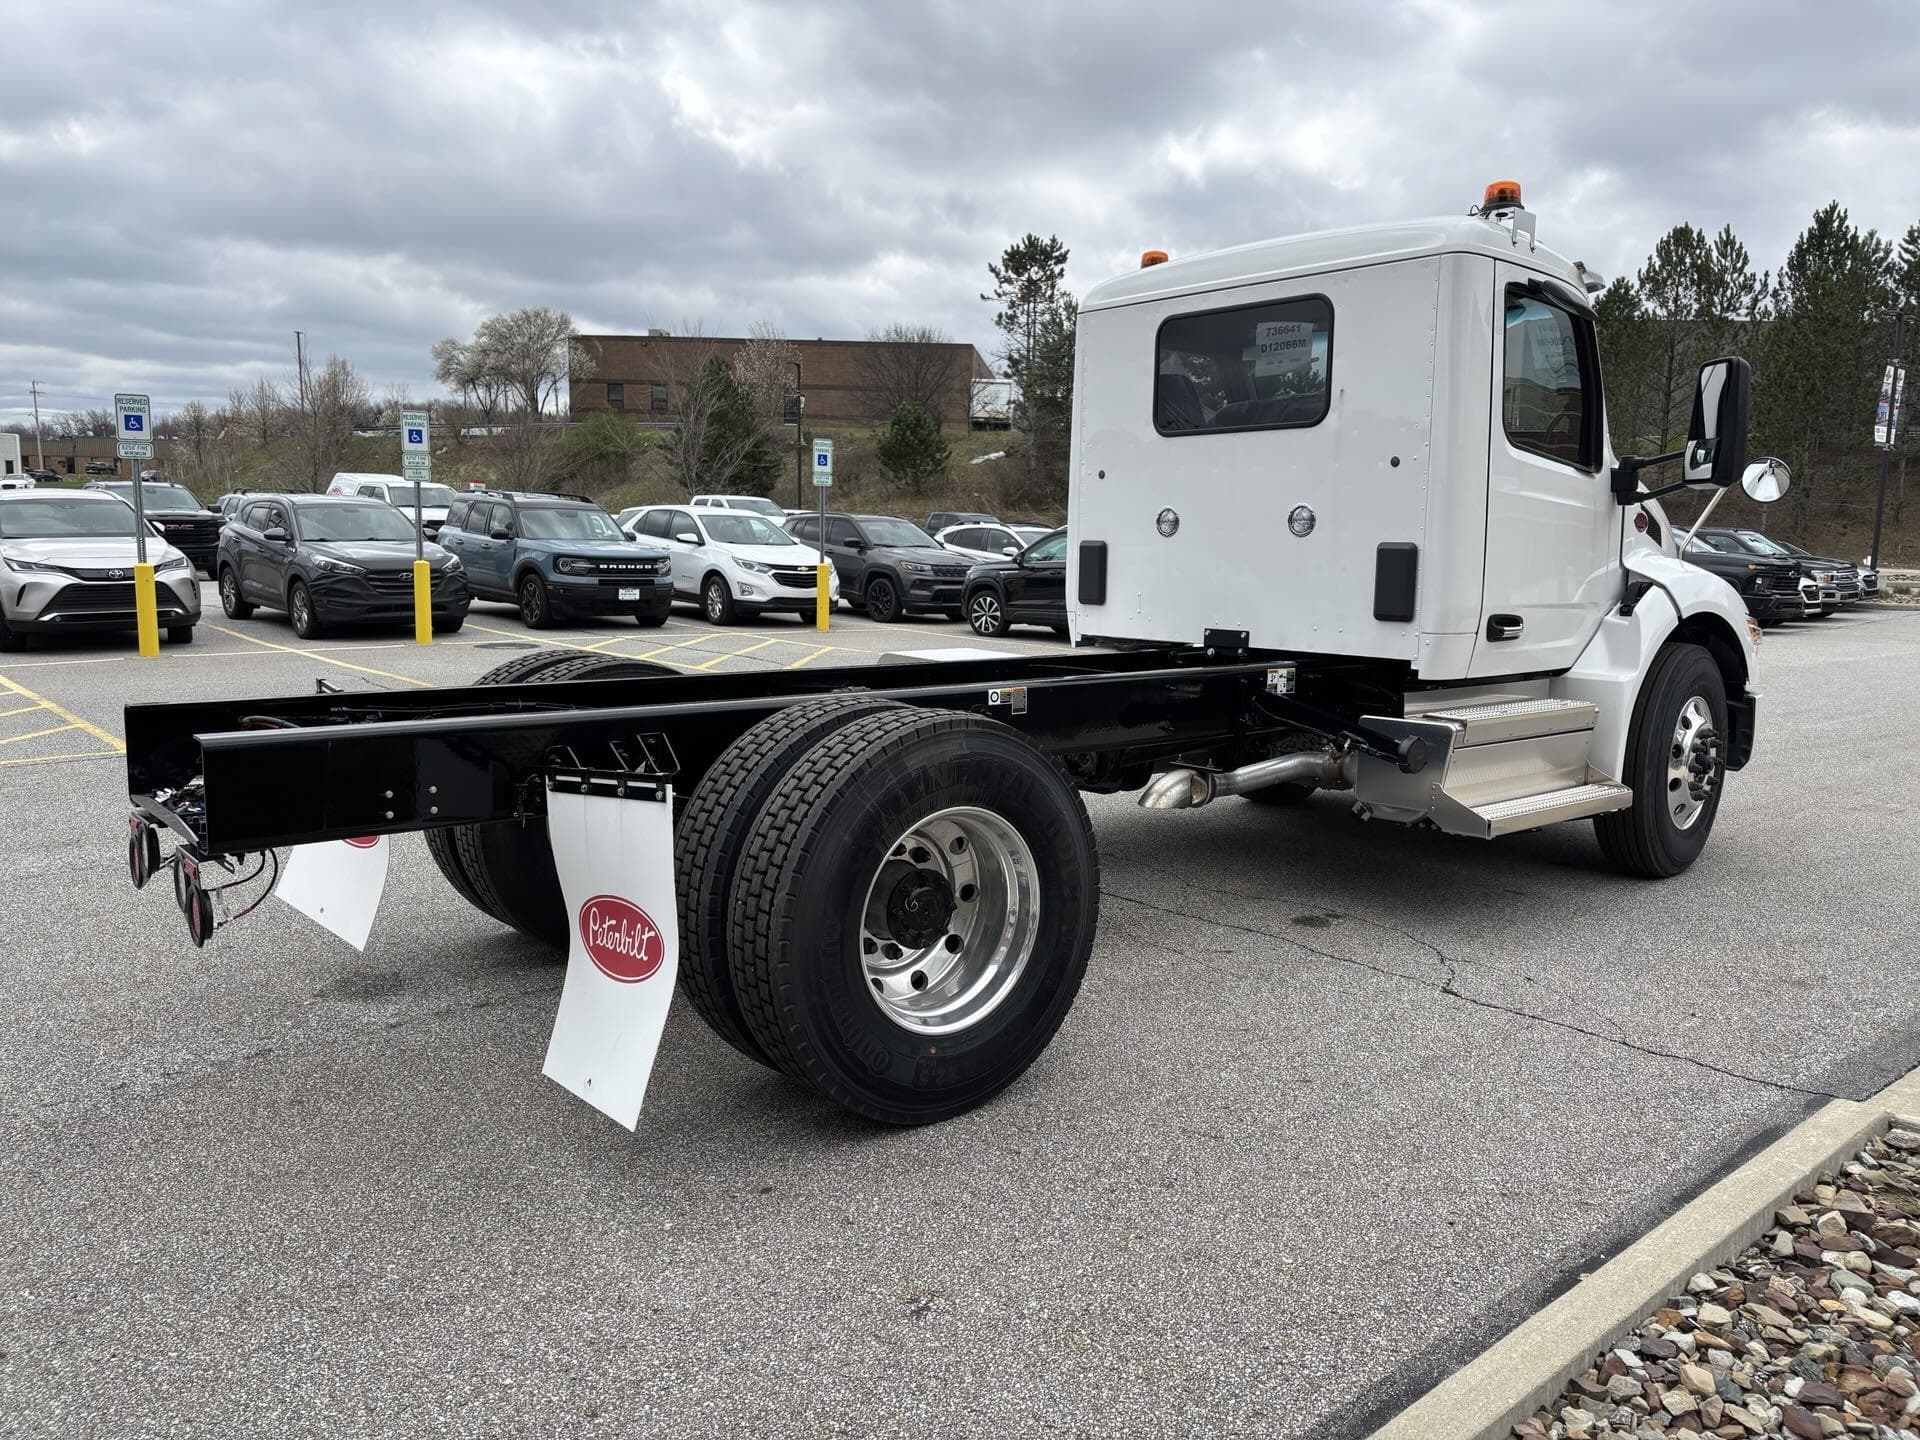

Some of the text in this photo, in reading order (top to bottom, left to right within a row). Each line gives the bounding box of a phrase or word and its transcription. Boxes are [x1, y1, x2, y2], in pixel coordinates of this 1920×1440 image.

[1265, 324, 1302, 336] 736641
[117, 398, 148, 406] RESERVED
[589, 907, 656, 961] Peterbilt
